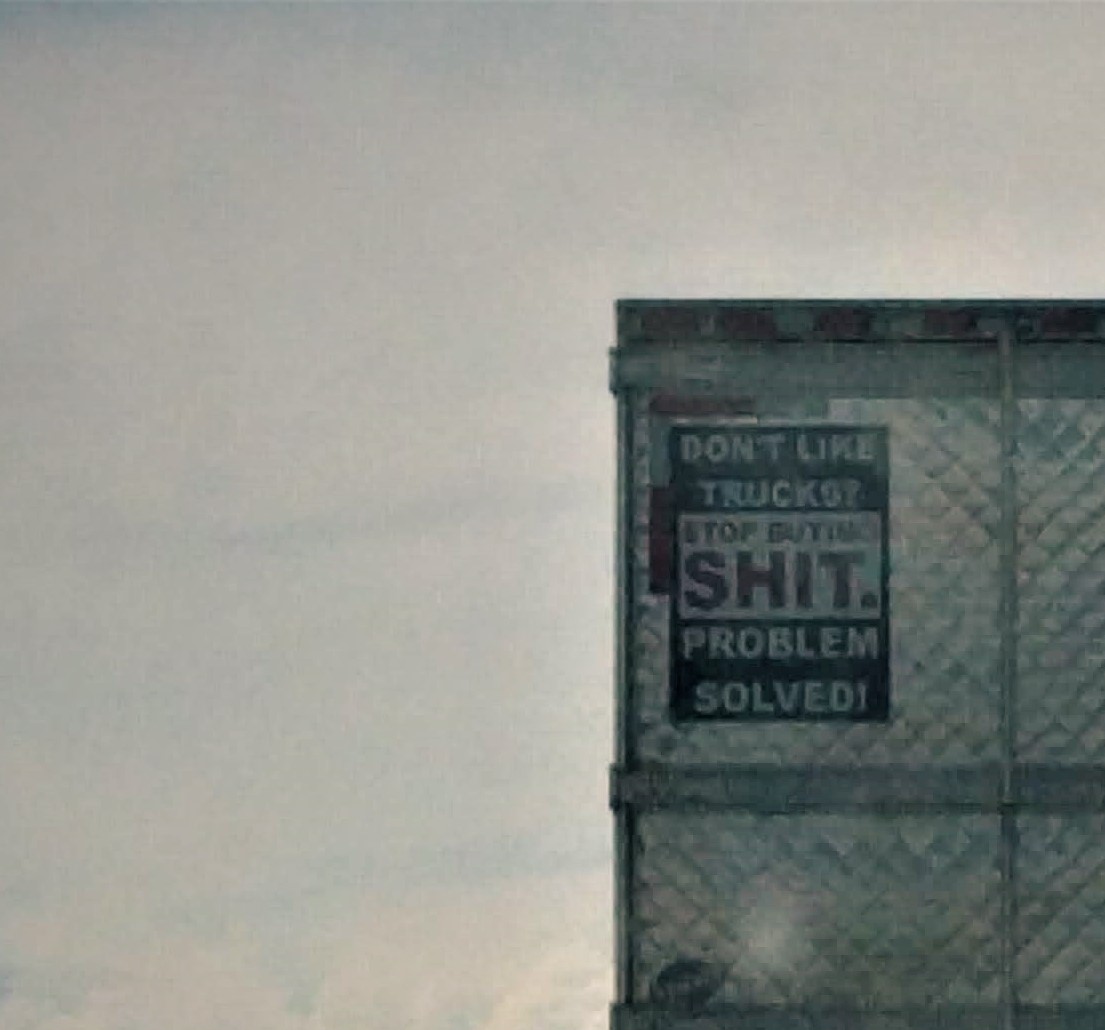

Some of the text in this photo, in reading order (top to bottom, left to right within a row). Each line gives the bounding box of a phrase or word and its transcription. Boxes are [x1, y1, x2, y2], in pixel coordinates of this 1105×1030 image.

[797, 433, 876, 462] LIKE
[684, 551, 878, 610] SHIT.
[682, 626, 878, 660] PROBLEM
[696, 682, 867, 713] SOLVED!
